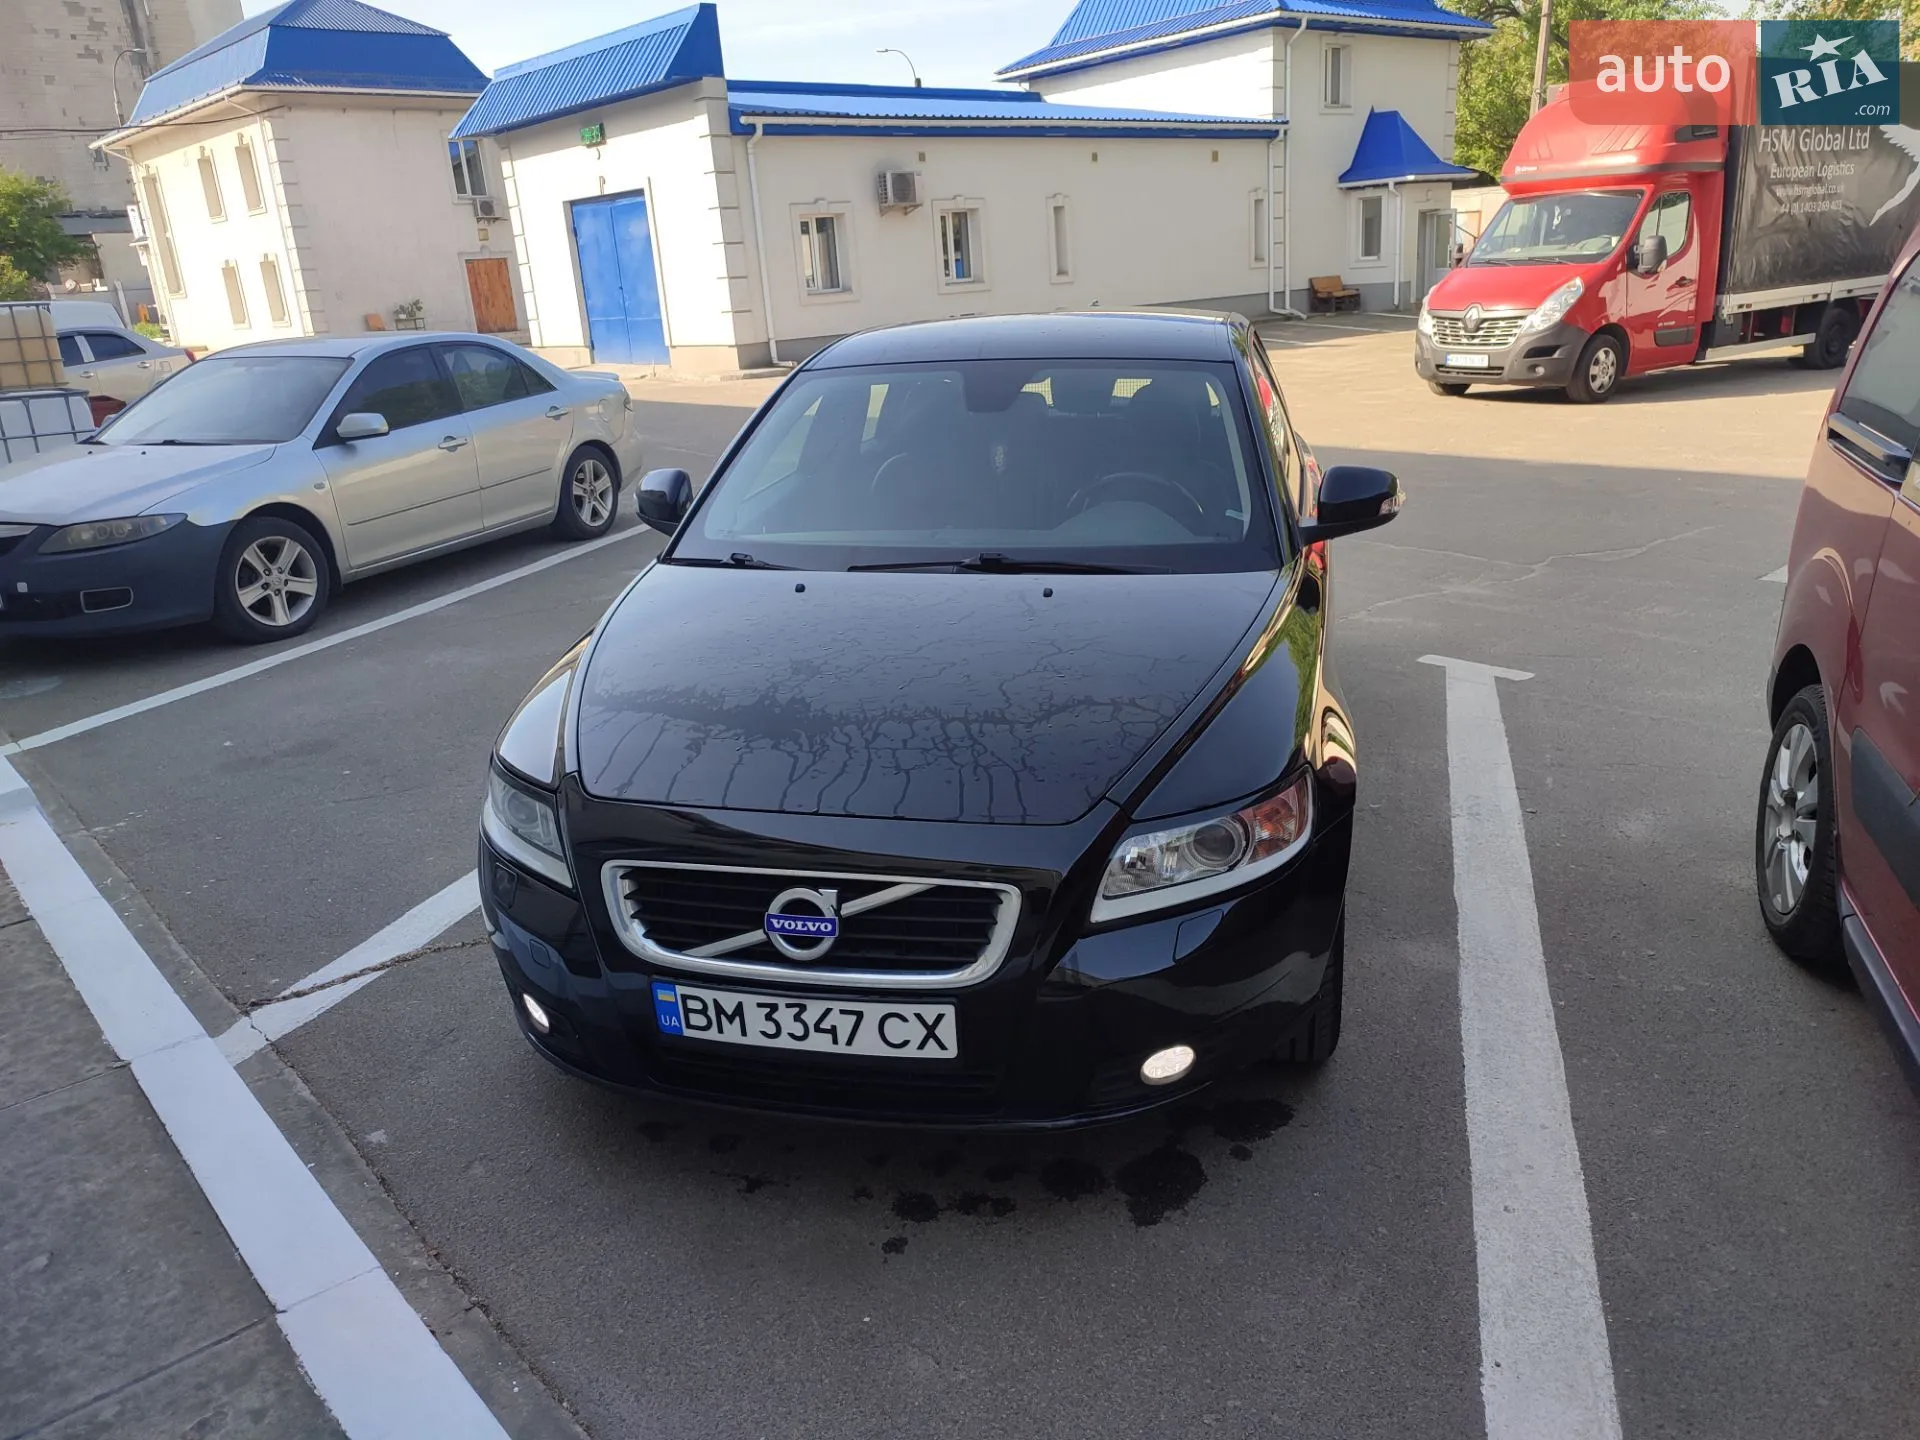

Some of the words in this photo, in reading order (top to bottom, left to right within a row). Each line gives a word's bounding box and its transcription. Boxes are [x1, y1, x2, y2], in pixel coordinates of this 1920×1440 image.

[1759, 128, 1796, 152] HSM
[1799, 126, 1846, 152] Global
[1848, 126, 1871, 150] Ltd
[1770, 163, 1815, 181] European
[1817, 161, 1855, 180] Logistics
[769, 918, 833, 933] VOLVO
[660, 1015, 680, 1028] UA
[680, 992, 748, 1038] BM
[755, 1002, 865, 1048] 3347
[877, 1012, 949, 1051] CX
